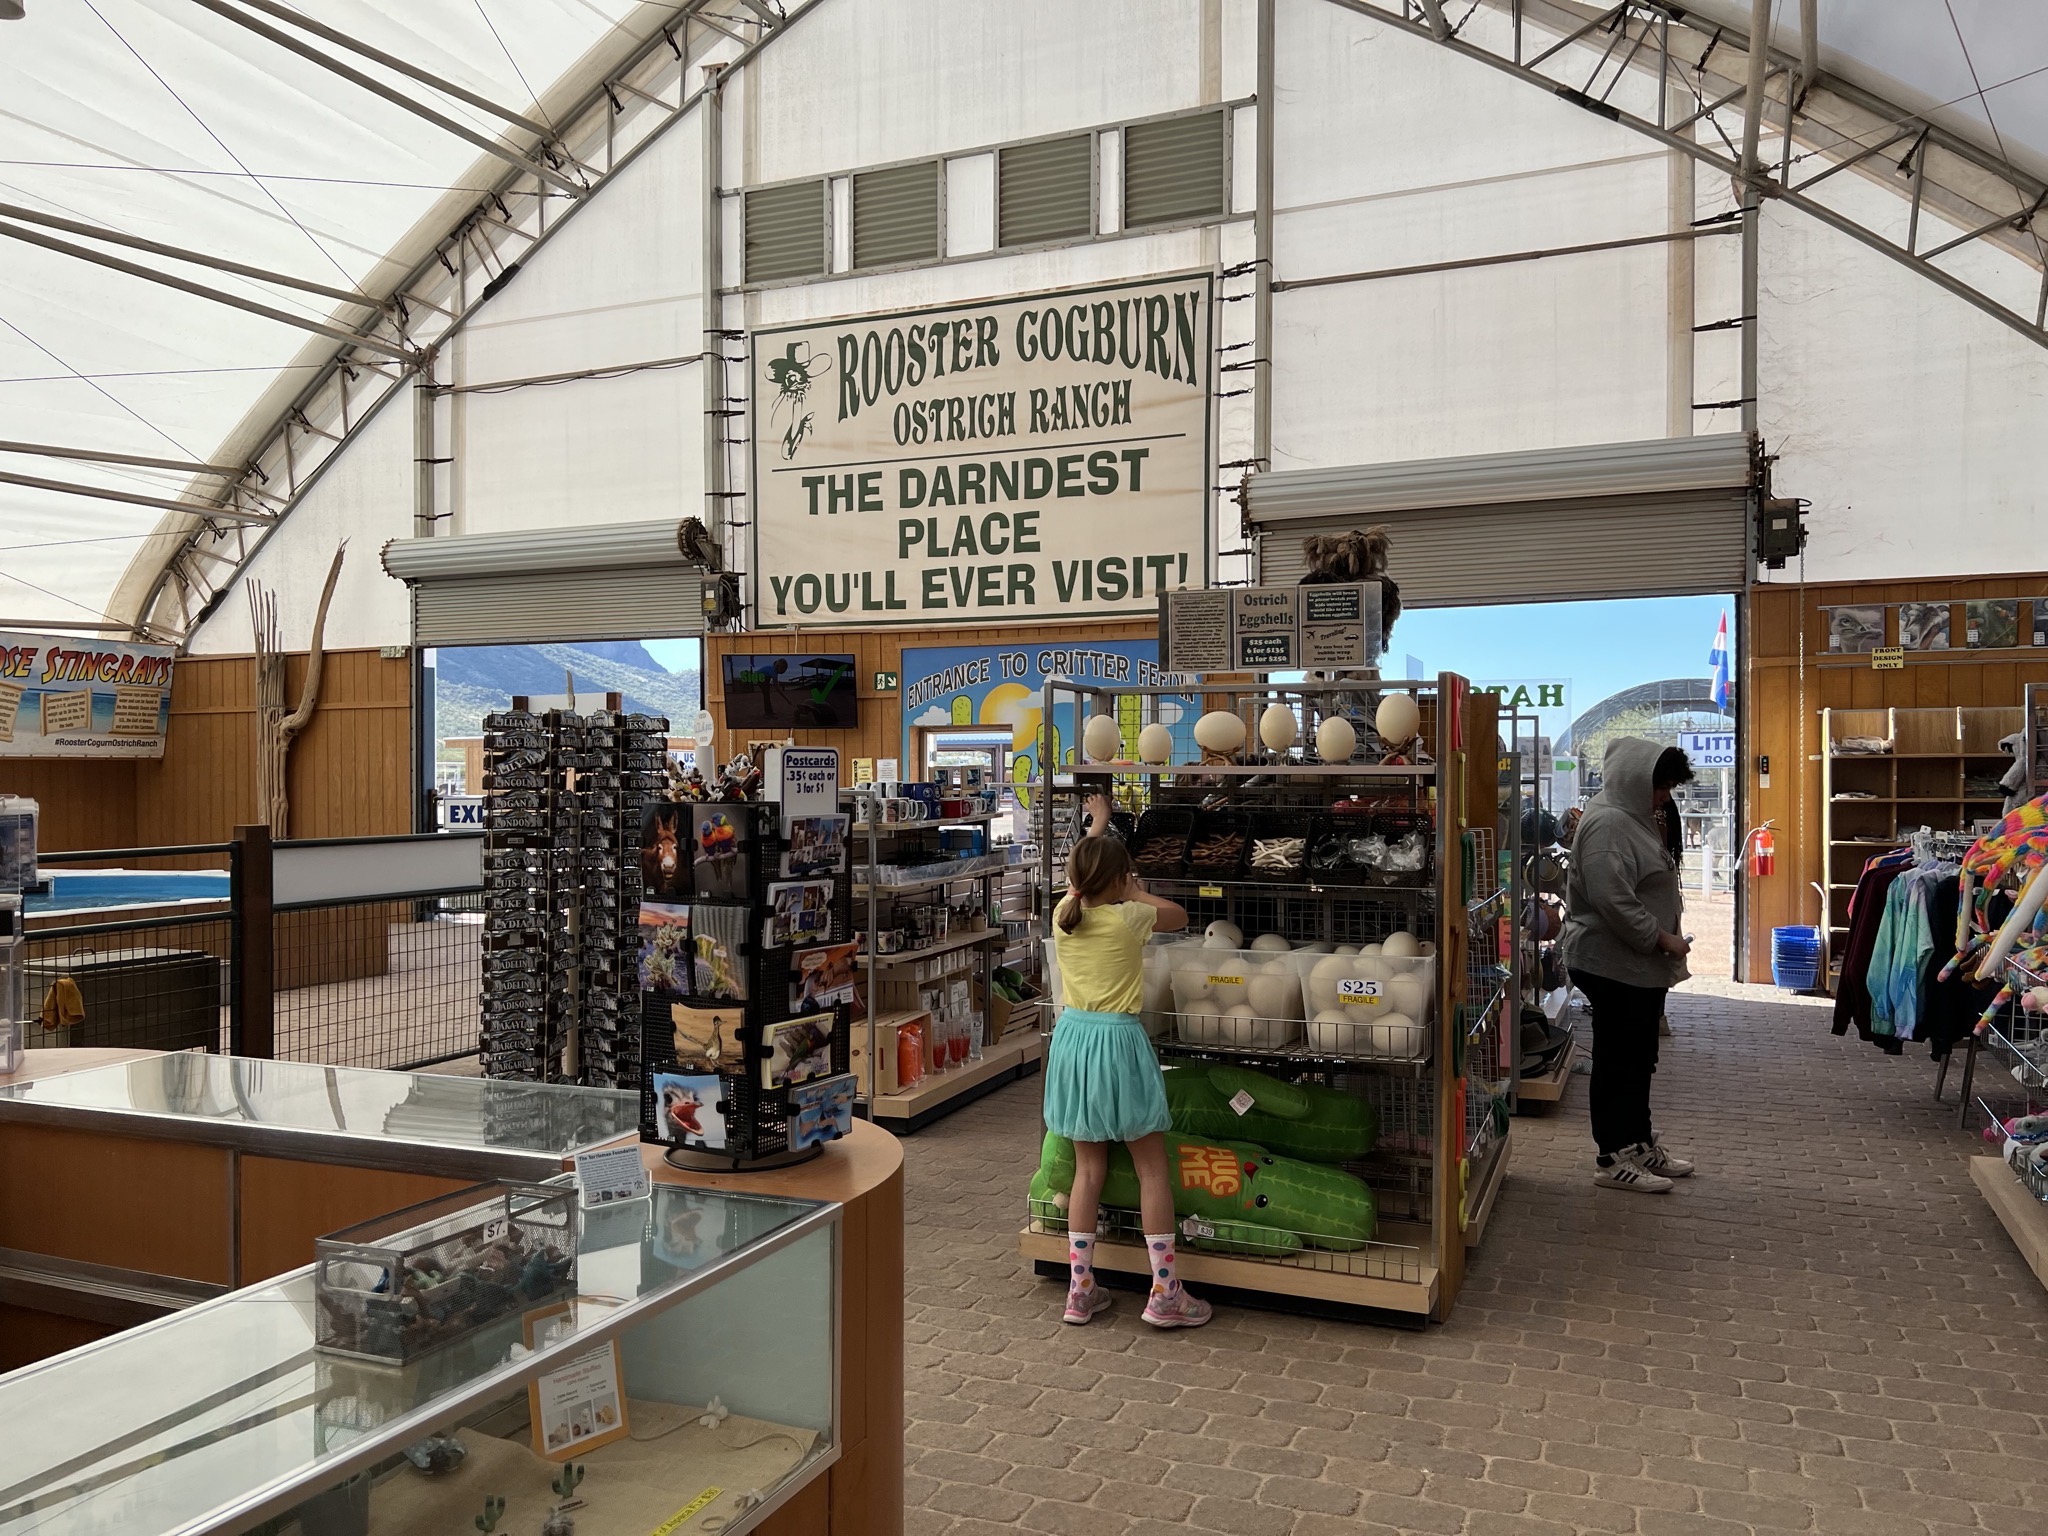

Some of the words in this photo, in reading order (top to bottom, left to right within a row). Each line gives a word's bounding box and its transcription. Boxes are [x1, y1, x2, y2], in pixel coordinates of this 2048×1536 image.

[837, 316, 999, 423] ROOSTER
[1017, 290, 1199, 387] COGBURN
[894, 391, 1016, 446] OSTRICH
[1030, 379, 1132, 435] RANCH
[802, 471, 883, 515] THE
[899, 448, 1149, 508] DARNDEST
[899, 511, 1040, 559] PLACE
[770, 570, 907, 616] YOU'LL
[922, 563, 1036, 610] EVER
[1052, 553, 1188, 602] VISIT!
[1244, 593, 1288, 606] Ostrich
[1239, 613, 1293, 628] Eggshells
[42, 646, 172, 686] STINGRAYS
[908, 658, 990, 712] ENTRANCE
[999, 651, 1028, 678] TO
[1037, 650, 1130, 682] CRITTER
[494, 714, 531, 727] LILLIAN
[786, 756, 835, 766] Postcards
[494, 776, 534, 787] LINCOLN
[808, 770, 826, 781] each
[828, 772, 835, 781] or
[797, 783, 801, 793] 3
[803, 782, 814, 793] for
[816, 782, 824, 793] $1
[494, 797, 527, 808] LOGAN
[494, 816, 531, 828] LONDON
[493, 898, 521, 909] LUKE
[493, 918, 528, 929] LYDIA
[1210, 976, 1241, 985] FRAGILE
[1343, 980, 1377, 995] $25
[1343, 995, 1375, 1004] FRAGILE
[491, 1000, 531, 1012] MADISON
[490, 1040, 526, 1052] MARCUS
[1180, 1147, 1211, 1187] ME
[1207, 1146, 1238, 1195] HUG
[487, 1220, 506, 1238] $7.
[1201, 1227, 1213, 1235] $39
[558, 1500, 583, 1511] ARIZONA
